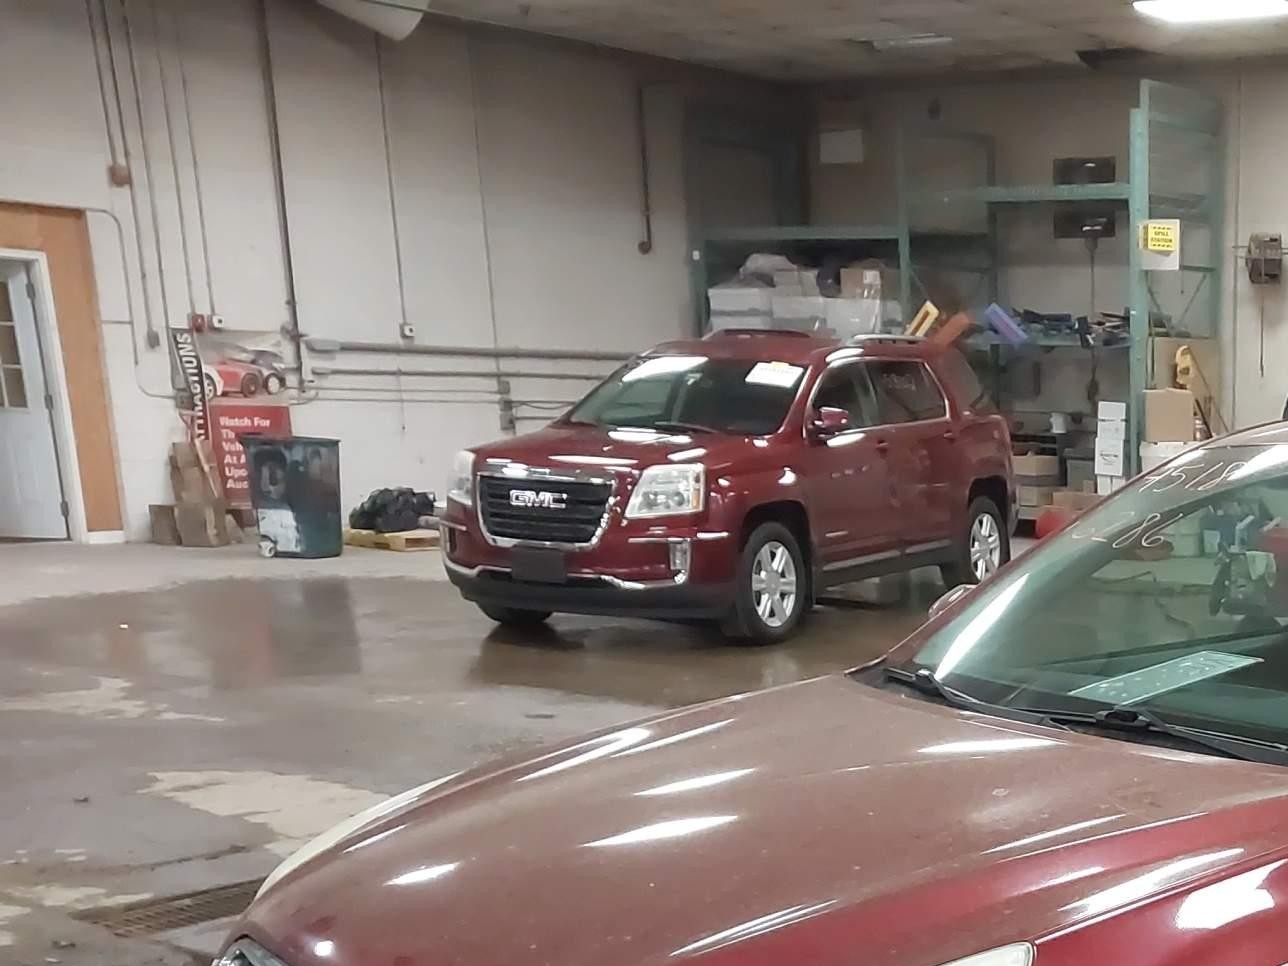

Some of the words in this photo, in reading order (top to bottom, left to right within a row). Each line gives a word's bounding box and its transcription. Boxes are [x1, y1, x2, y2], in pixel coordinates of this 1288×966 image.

[219, 416, 252, 427] Watch
[253, 417, 271, 428] For
[509, 489, 568, 509] GMC
